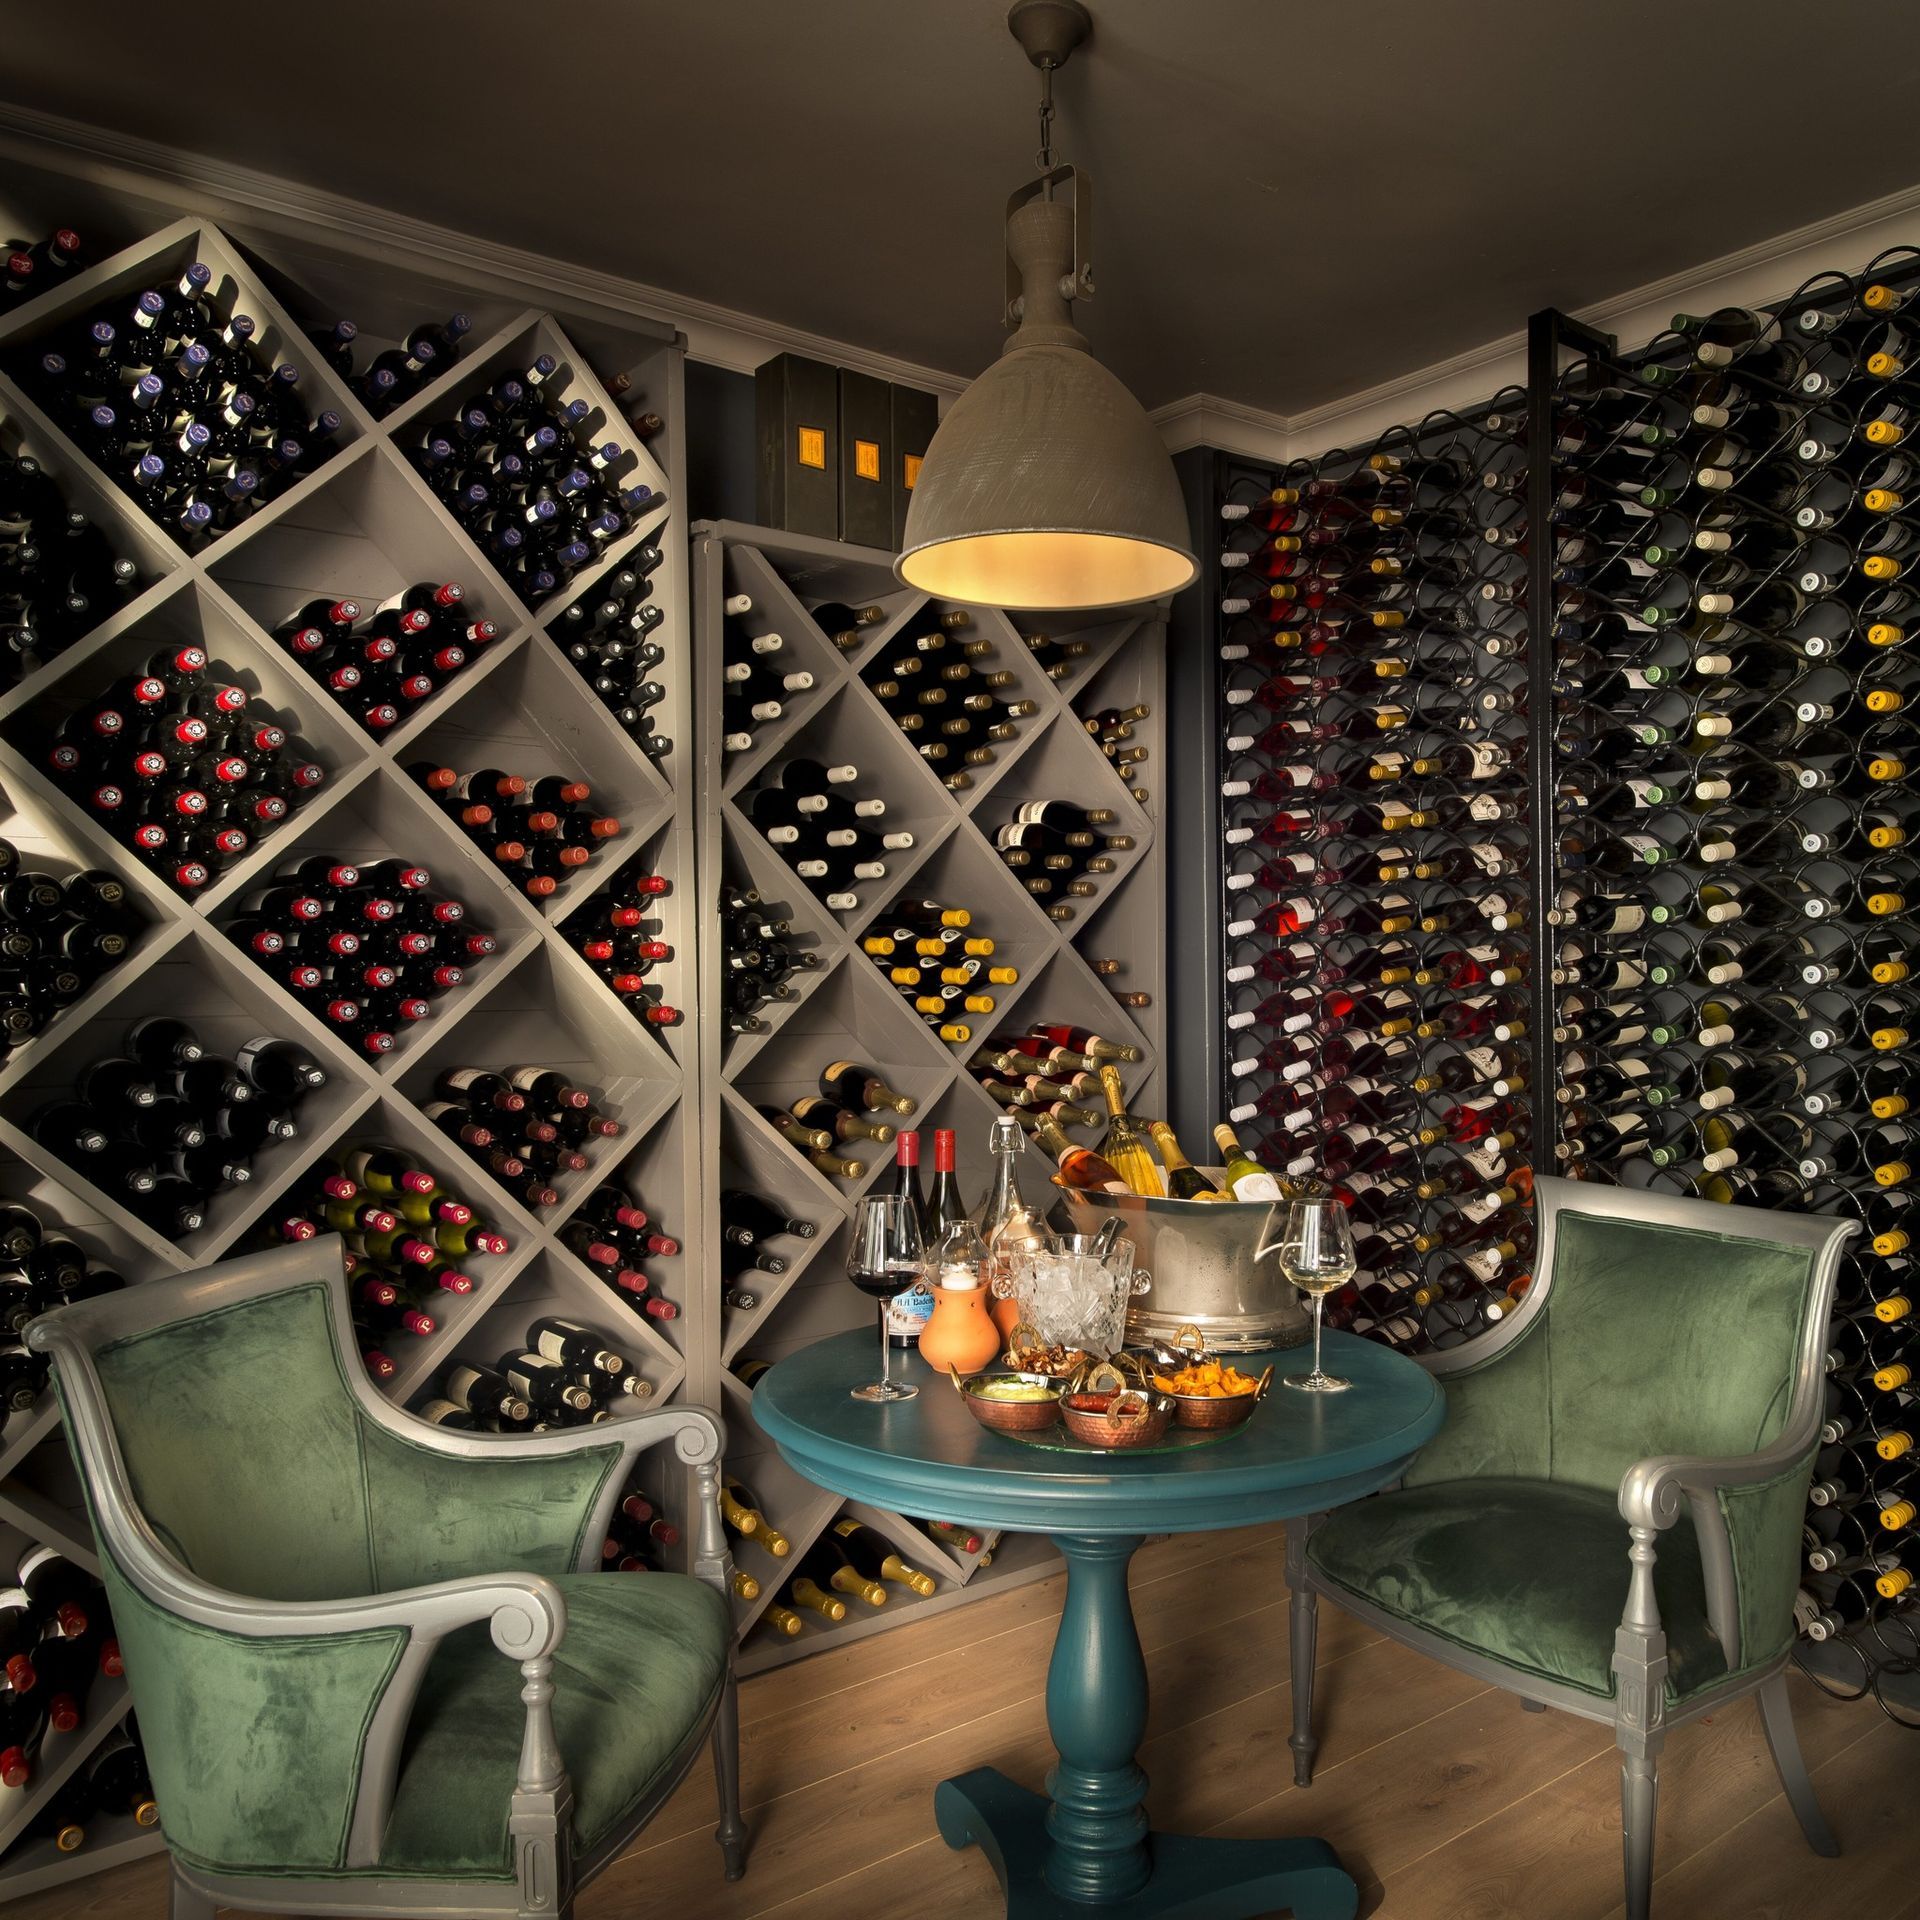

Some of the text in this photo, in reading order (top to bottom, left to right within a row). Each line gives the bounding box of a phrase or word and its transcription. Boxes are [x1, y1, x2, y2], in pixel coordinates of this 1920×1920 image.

[341, 1184, 352, 1196] J
[302, 1226, 313, 1238] J
[495, 1240, 505, 1252] J
